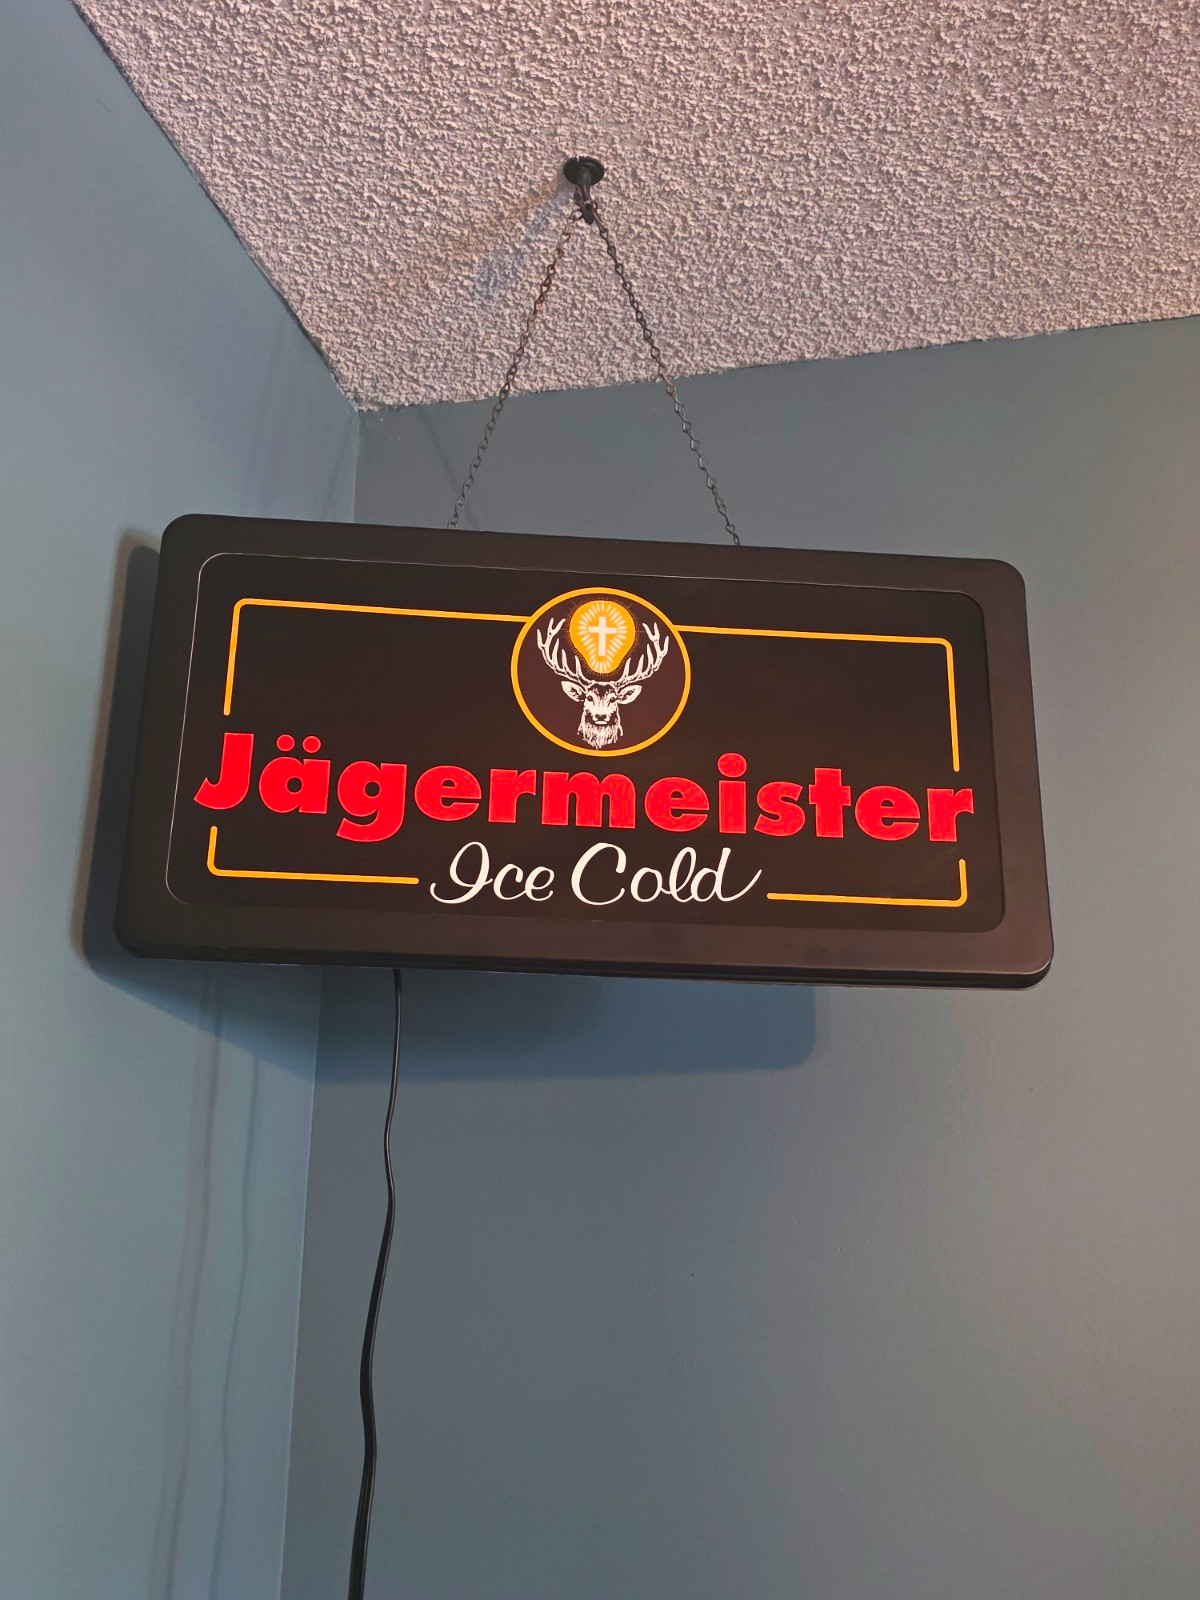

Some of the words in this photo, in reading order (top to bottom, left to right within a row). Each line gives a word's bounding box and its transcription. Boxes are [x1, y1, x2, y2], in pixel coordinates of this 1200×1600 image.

[193, 732, 975, 844] Jägermeister
[429, 841, 555, 904] Ice
[570, 842, 762, 905] Cold
